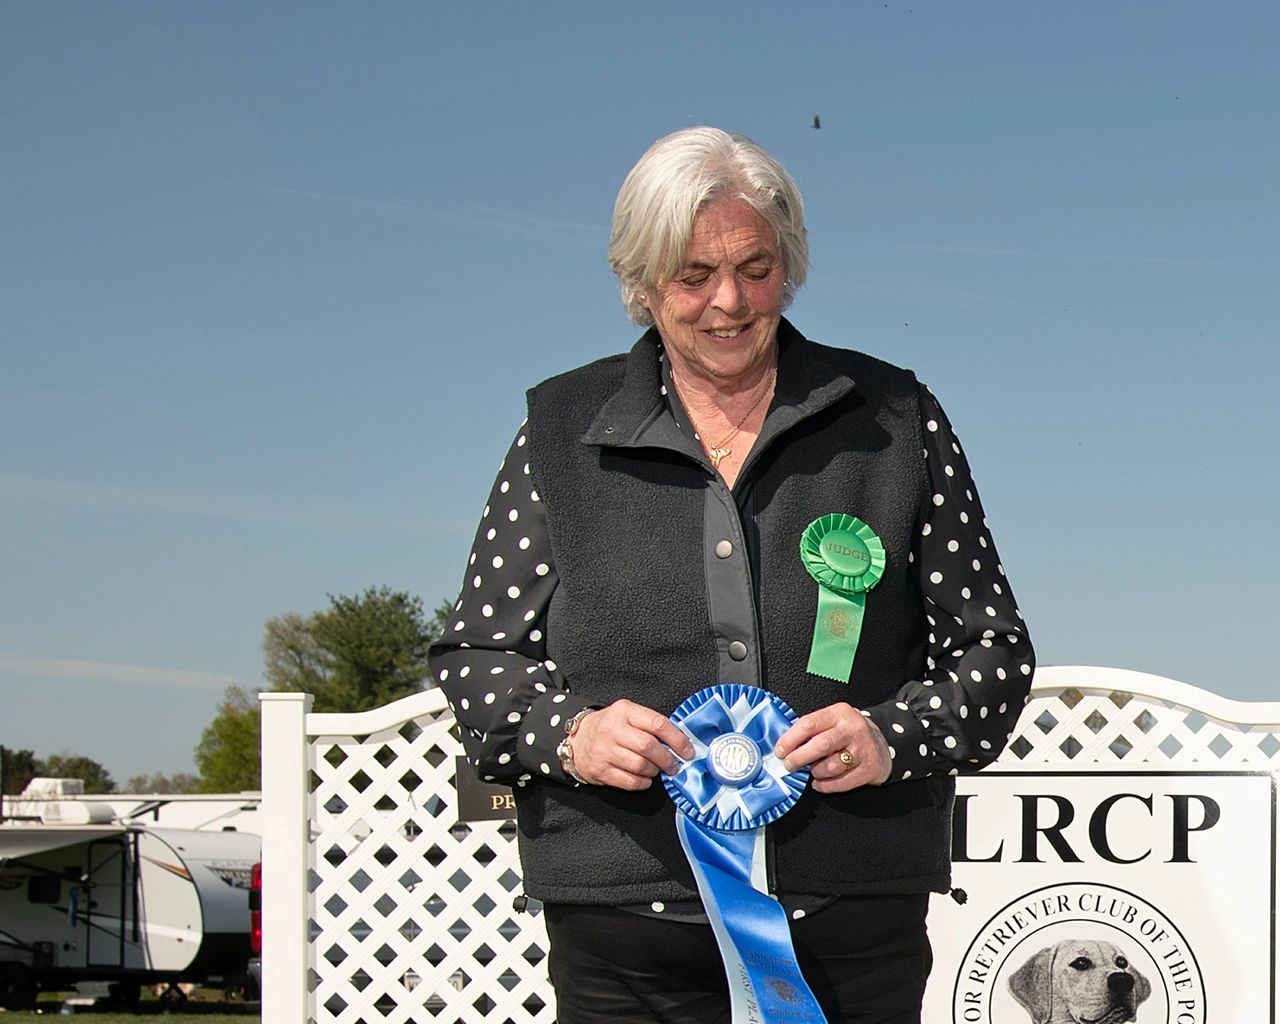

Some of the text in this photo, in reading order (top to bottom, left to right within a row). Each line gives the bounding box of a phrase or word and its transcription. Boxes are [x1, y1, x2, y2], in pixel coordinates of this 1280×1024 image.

[827, 543, 868, 561] JUDGE
[951, 793, 1221, 864] LRCP
[969, 894, 1071, 984] RETRIEVER
[1078, 893, 1138, 924] CLUB
[1139, 918, 1170, 945] OF
[1162, 944, 1194, 992] THE
